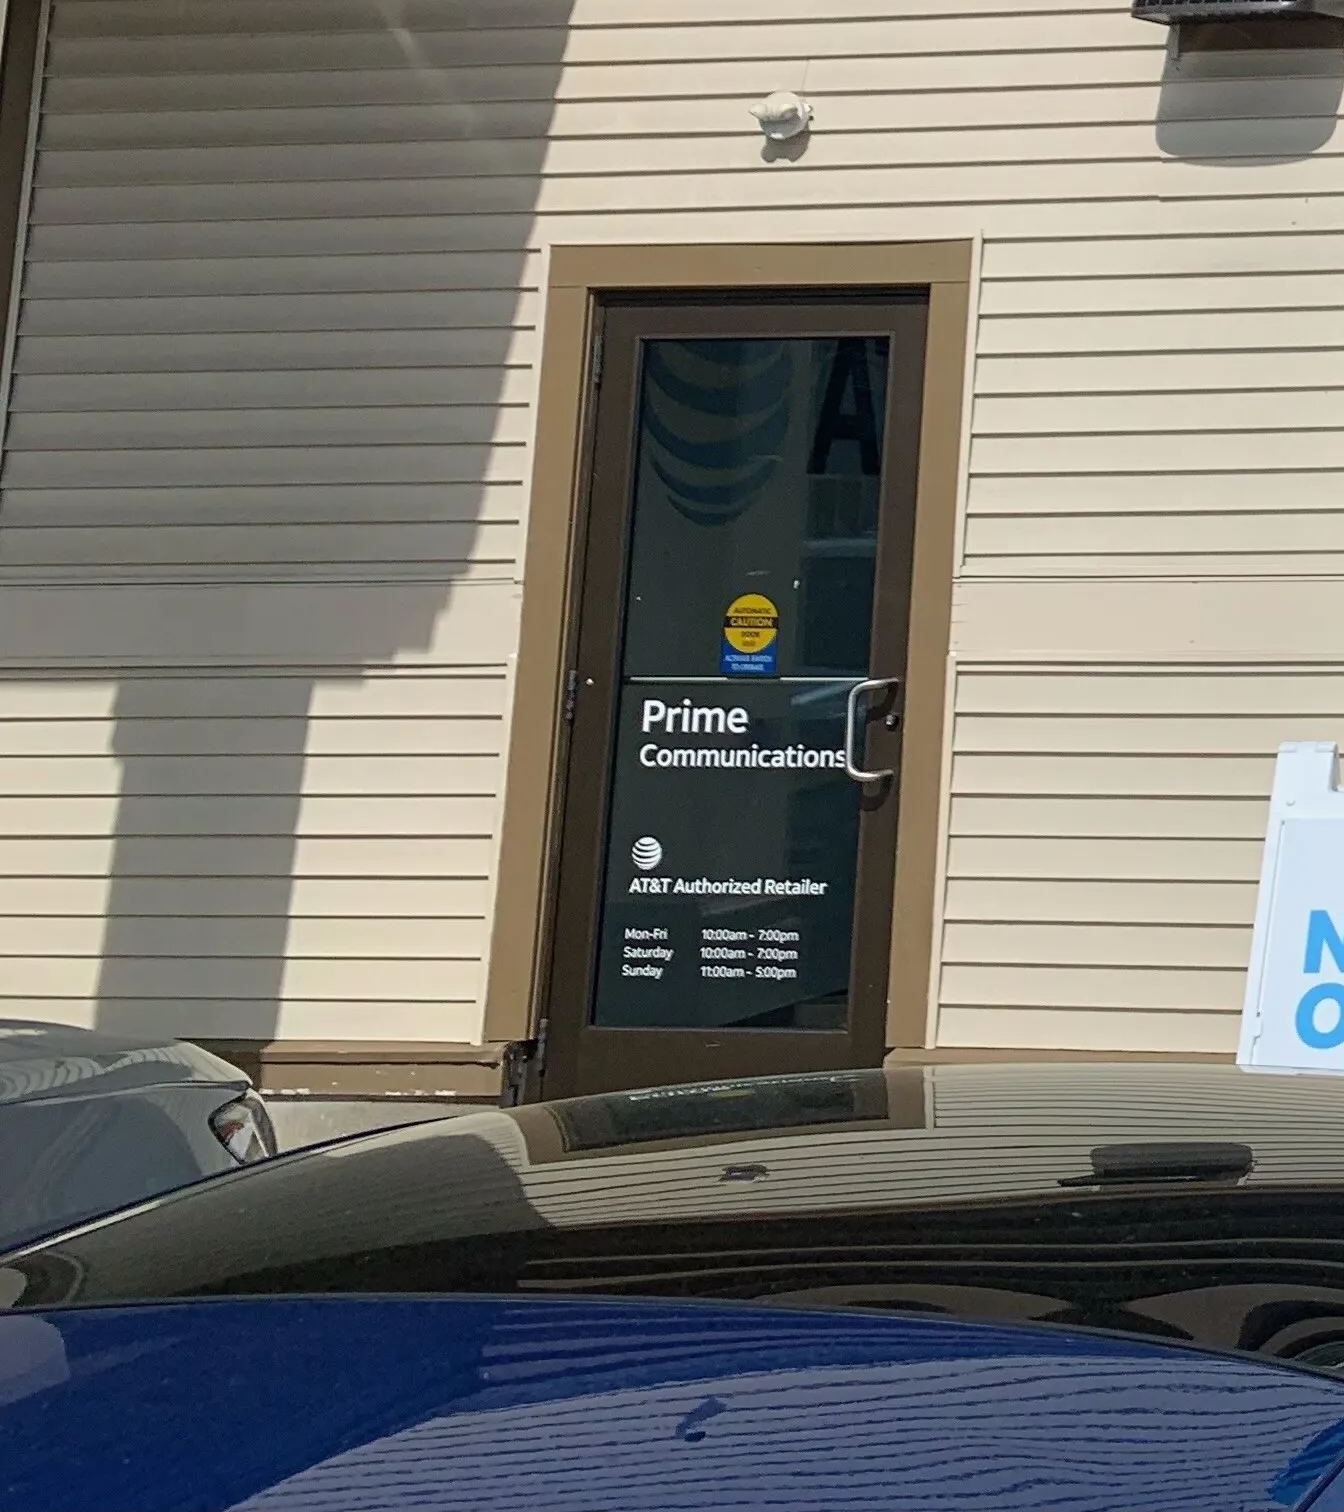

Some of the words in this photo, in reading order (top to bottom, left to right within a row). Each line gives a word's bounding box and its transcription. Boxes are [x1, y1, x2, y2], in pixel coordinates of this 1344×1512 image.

[729, 617, 774, 627] CAUTION
[642, 698, 750, 734] Prime
[639, 743, 846, 768] Communications
[628, 877, 673, 894] AT&T
[673, 877, 762, 895] Authorized
[764, 878, 828, 895] Retailer
[624, 928, 669, 940] Mon-Fri
[701, 929, 747, 941] 10:00am
[758, 929, 800, 944] 7:00pm
[623, 946, 674, 961] Saturday
[700, 947, 746, 959] 10:00am
[757, 948, 799, 962] 7:00pm
[621, 964, 664, 979] Sunday
[700, 966, 745, 978] 11:00am
[755, 966, 797, 980] 5:00pm
